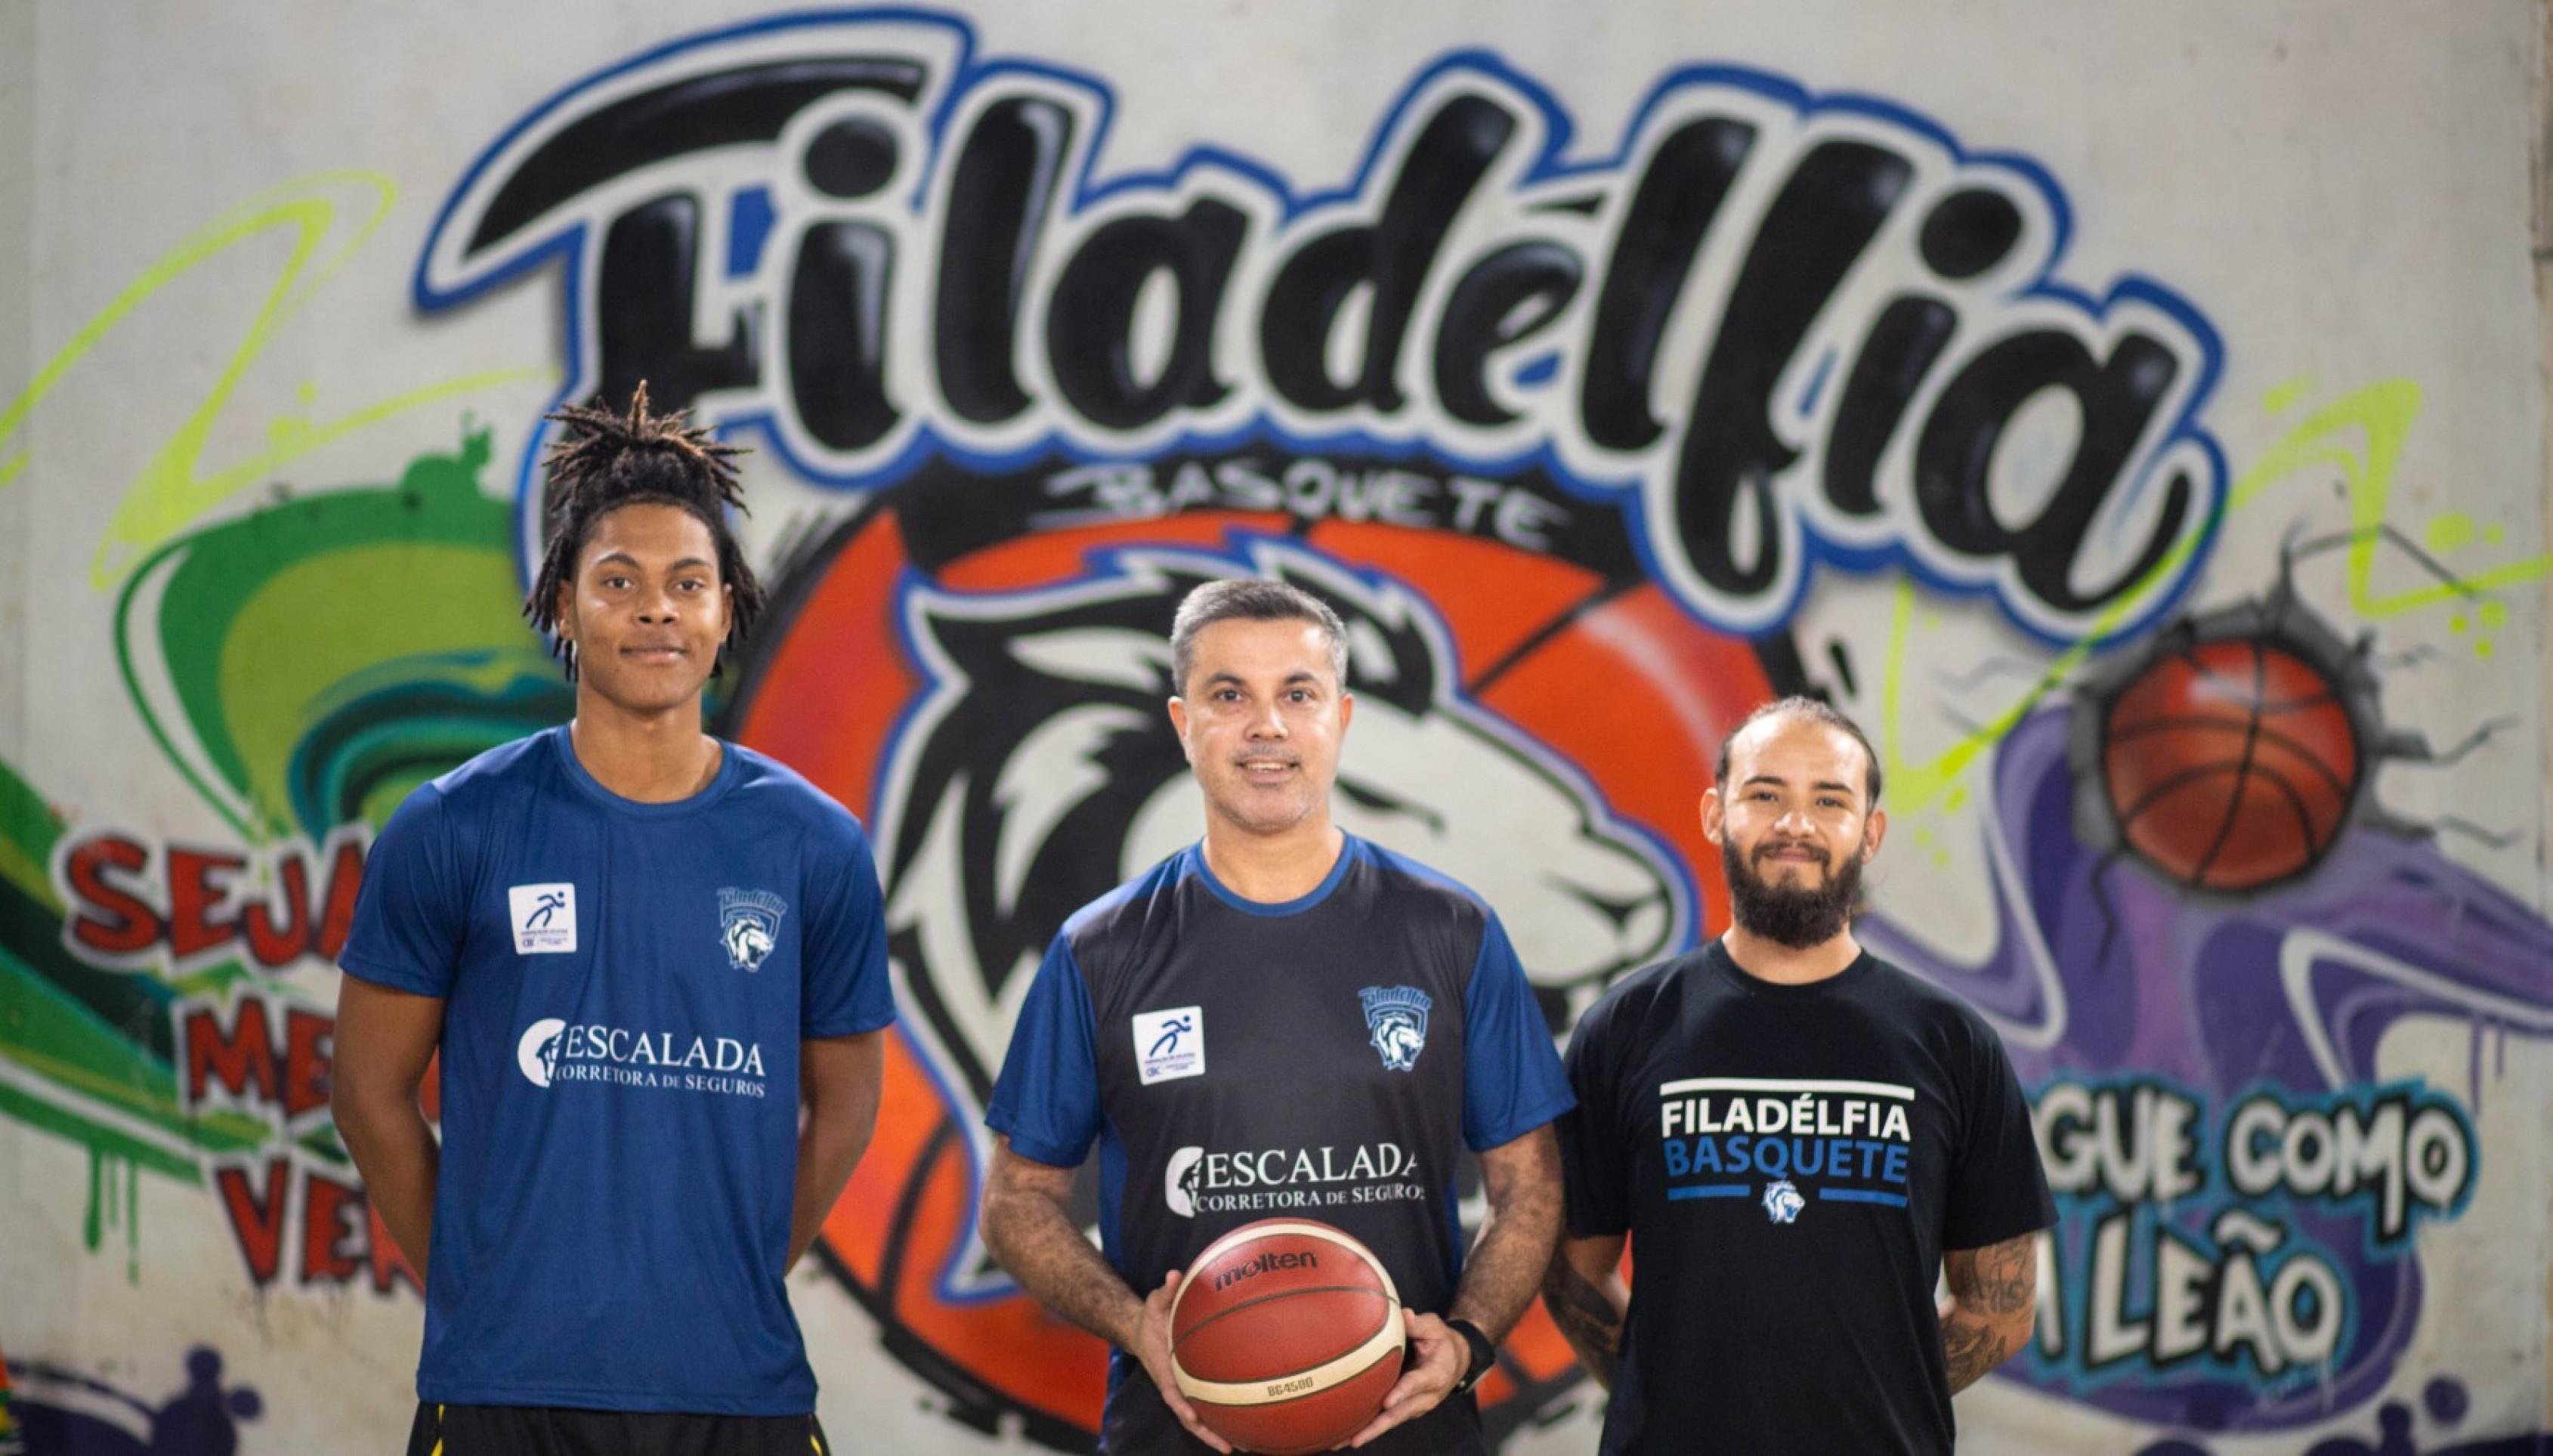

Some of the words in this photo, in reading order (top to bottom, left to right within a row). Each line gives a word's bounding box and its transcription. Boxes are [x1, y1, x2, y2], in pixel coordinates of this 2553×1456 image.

[452, 47, 2197, 618] Filadélfia
[1029, 456, 1572, 553] BASQUETE
[565, 1024, 766, 1077] ESCALADA
[685, 1074, 766, 1099] SEGUROS
[1661, 1093, 1911, 1142] FILADÉLFIA
[1662, 1135, 1910, 1184] BASQUETE
[2030, 1082, 2201, 1203] GUE
[2230, 1095, 2469, 1237] COMO
[1196, 1189, 1321, 1213] CORRETORA
[1325, 1190, 1349, 1205] DE
[1351, 1182, 1426, 1204] SEGURO
[1214, 1250, 1318, 1293] molten
[2088, 1209, 2342, 1376] LEÃO
